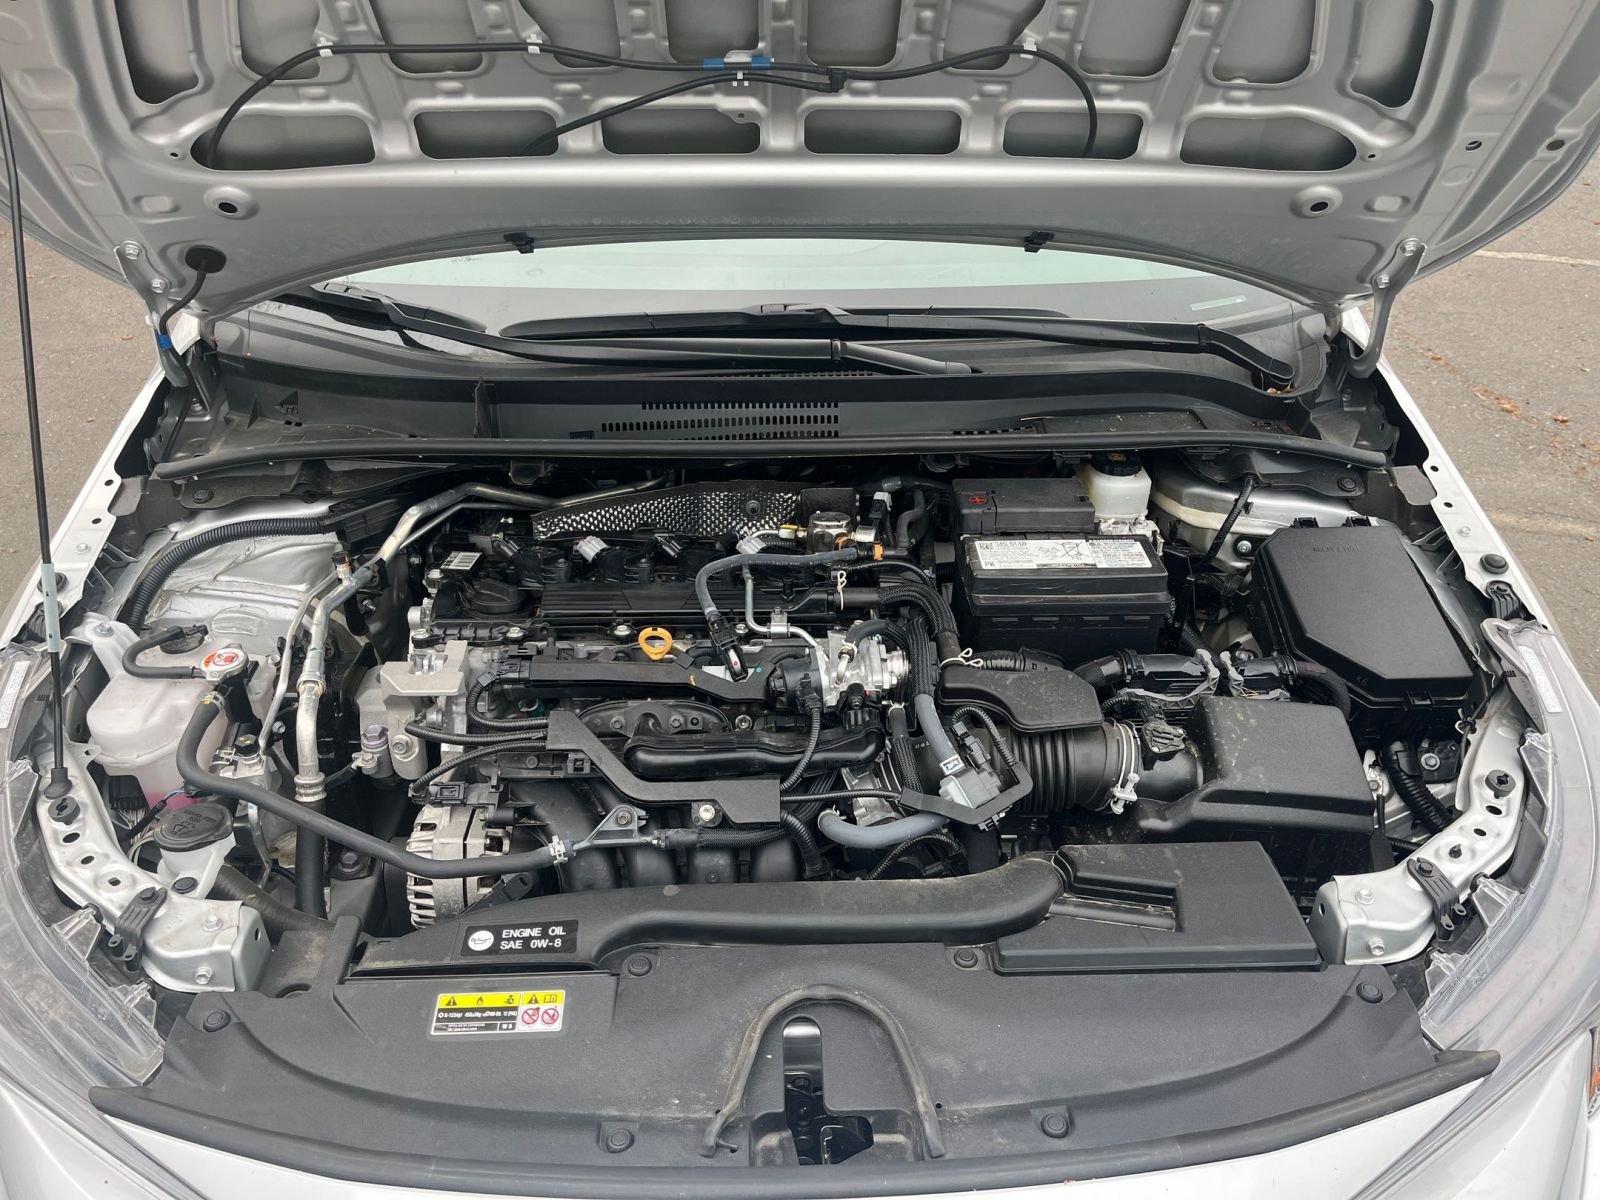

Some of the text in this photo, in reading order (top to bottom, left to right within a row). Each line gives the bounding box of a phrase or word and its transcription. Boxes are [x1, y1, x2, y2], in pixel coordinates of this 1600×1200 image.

[501, 926, 566, 938] ENGINE OIL
[499, 938, 562, 950] SAE 0W-8
